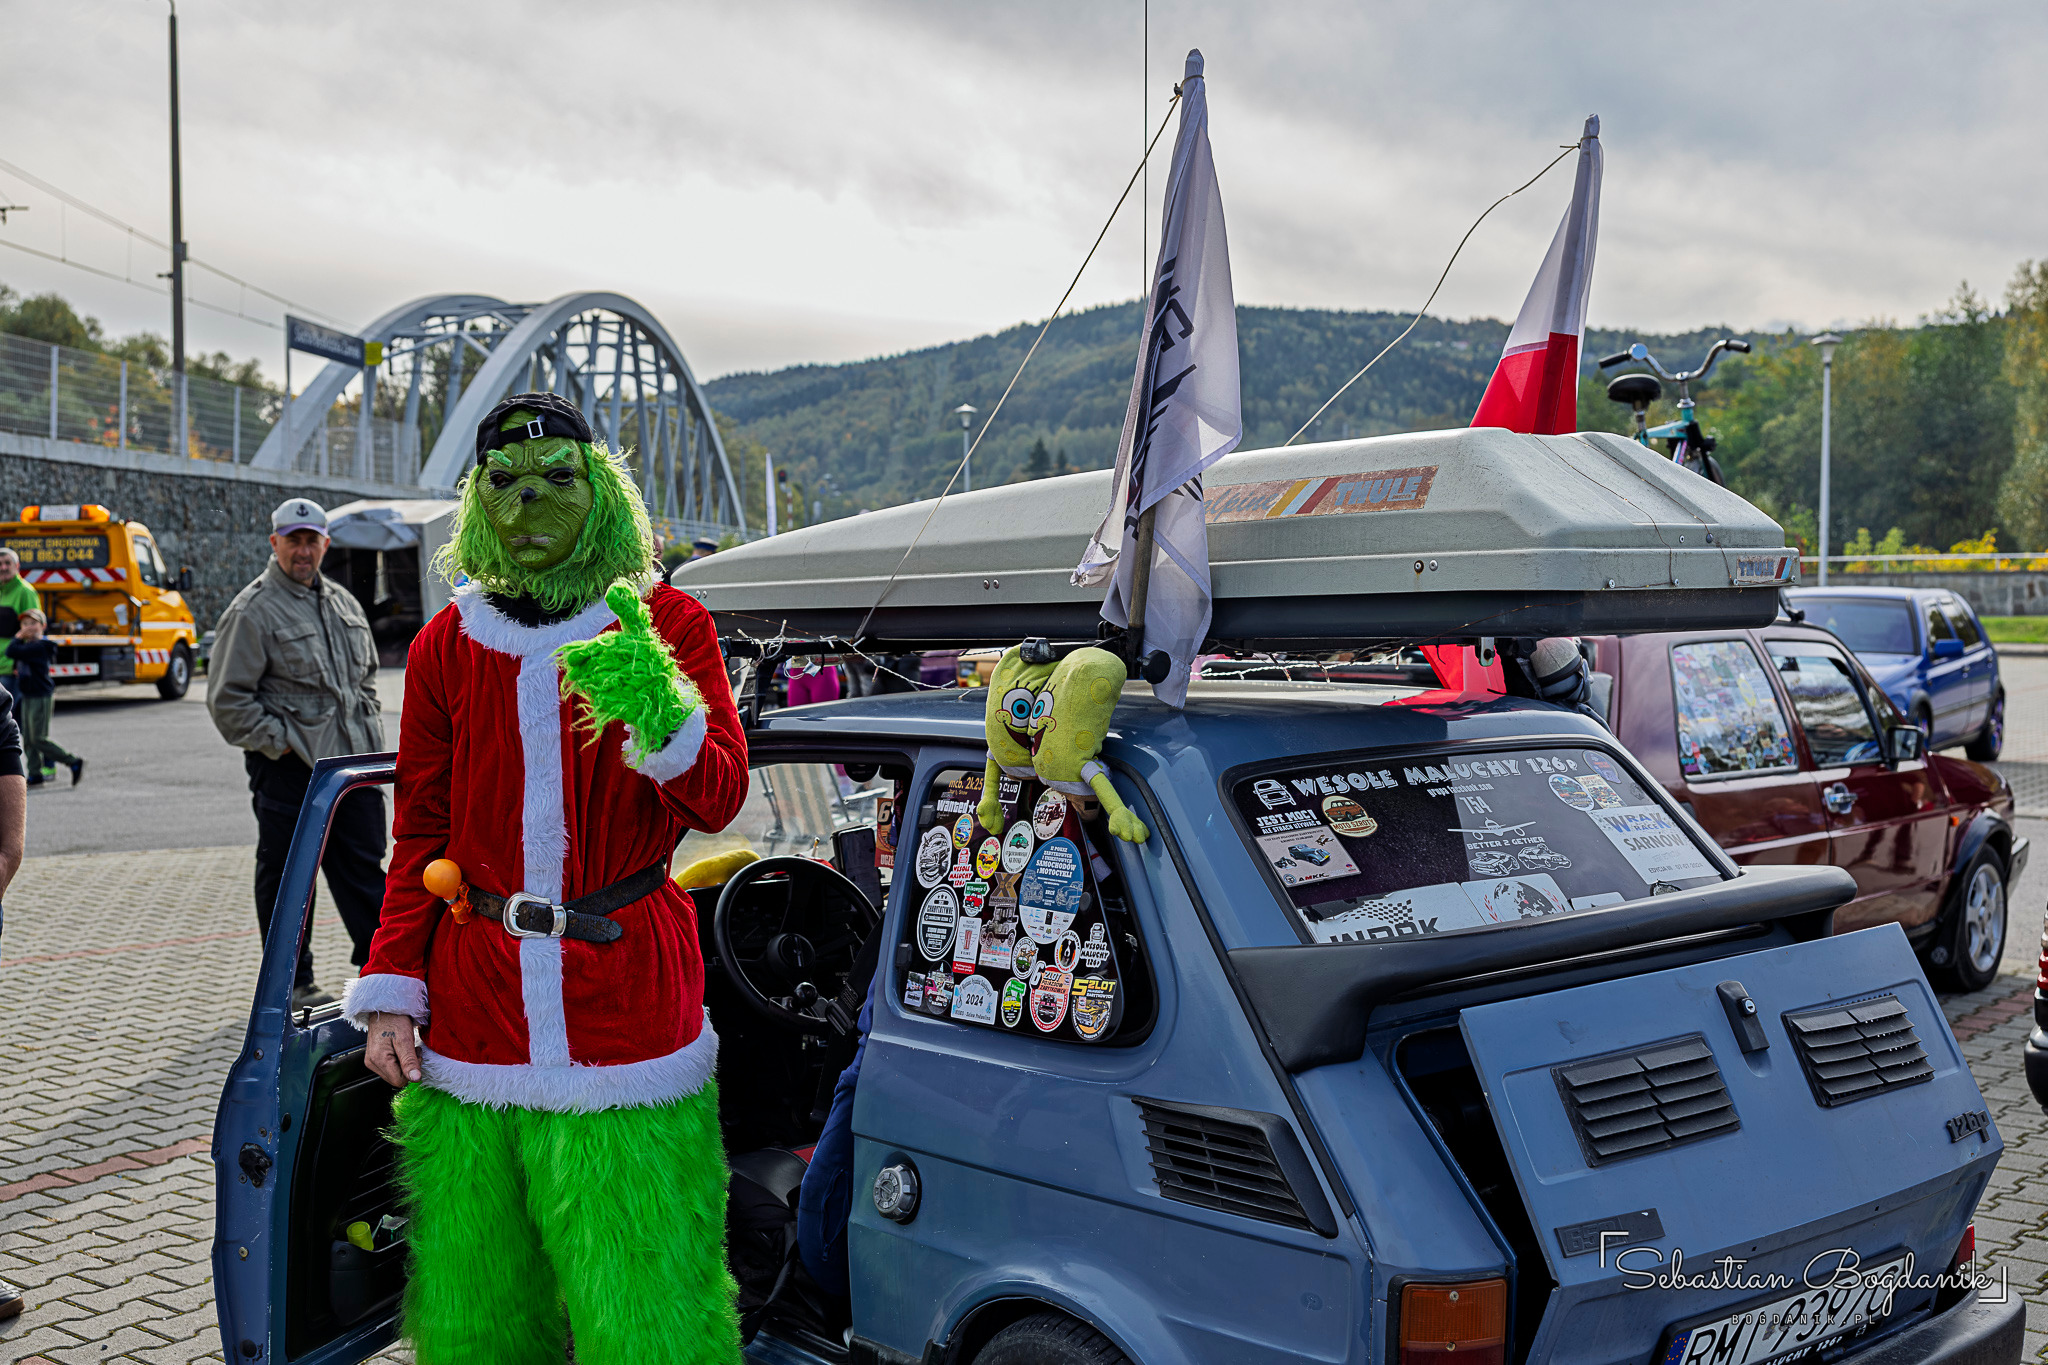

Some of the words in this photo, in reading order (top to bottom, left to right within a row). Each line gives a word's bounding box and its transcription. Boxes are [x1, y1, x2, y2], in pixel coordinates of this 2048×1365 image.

[1334, 476, 1423, 506] THULE
[1403, 759, 1521, 785] MALUCHY
[1256, 813, 1284, 827] JEST
[1603, 812, 1671, 833] WRAK
[1634, 823, 1659, 831] RACE
[1467, 840, 1502, 850] BETTER
[1511, 836, 1545, 845] GETHER
[1623, 831, 1684, 851] SARNÓW
[1072, 979, 1090, 996] 5
[1088, 980, 1115, 992] ZLOT
[966, 994, 984, 1006] 2024
